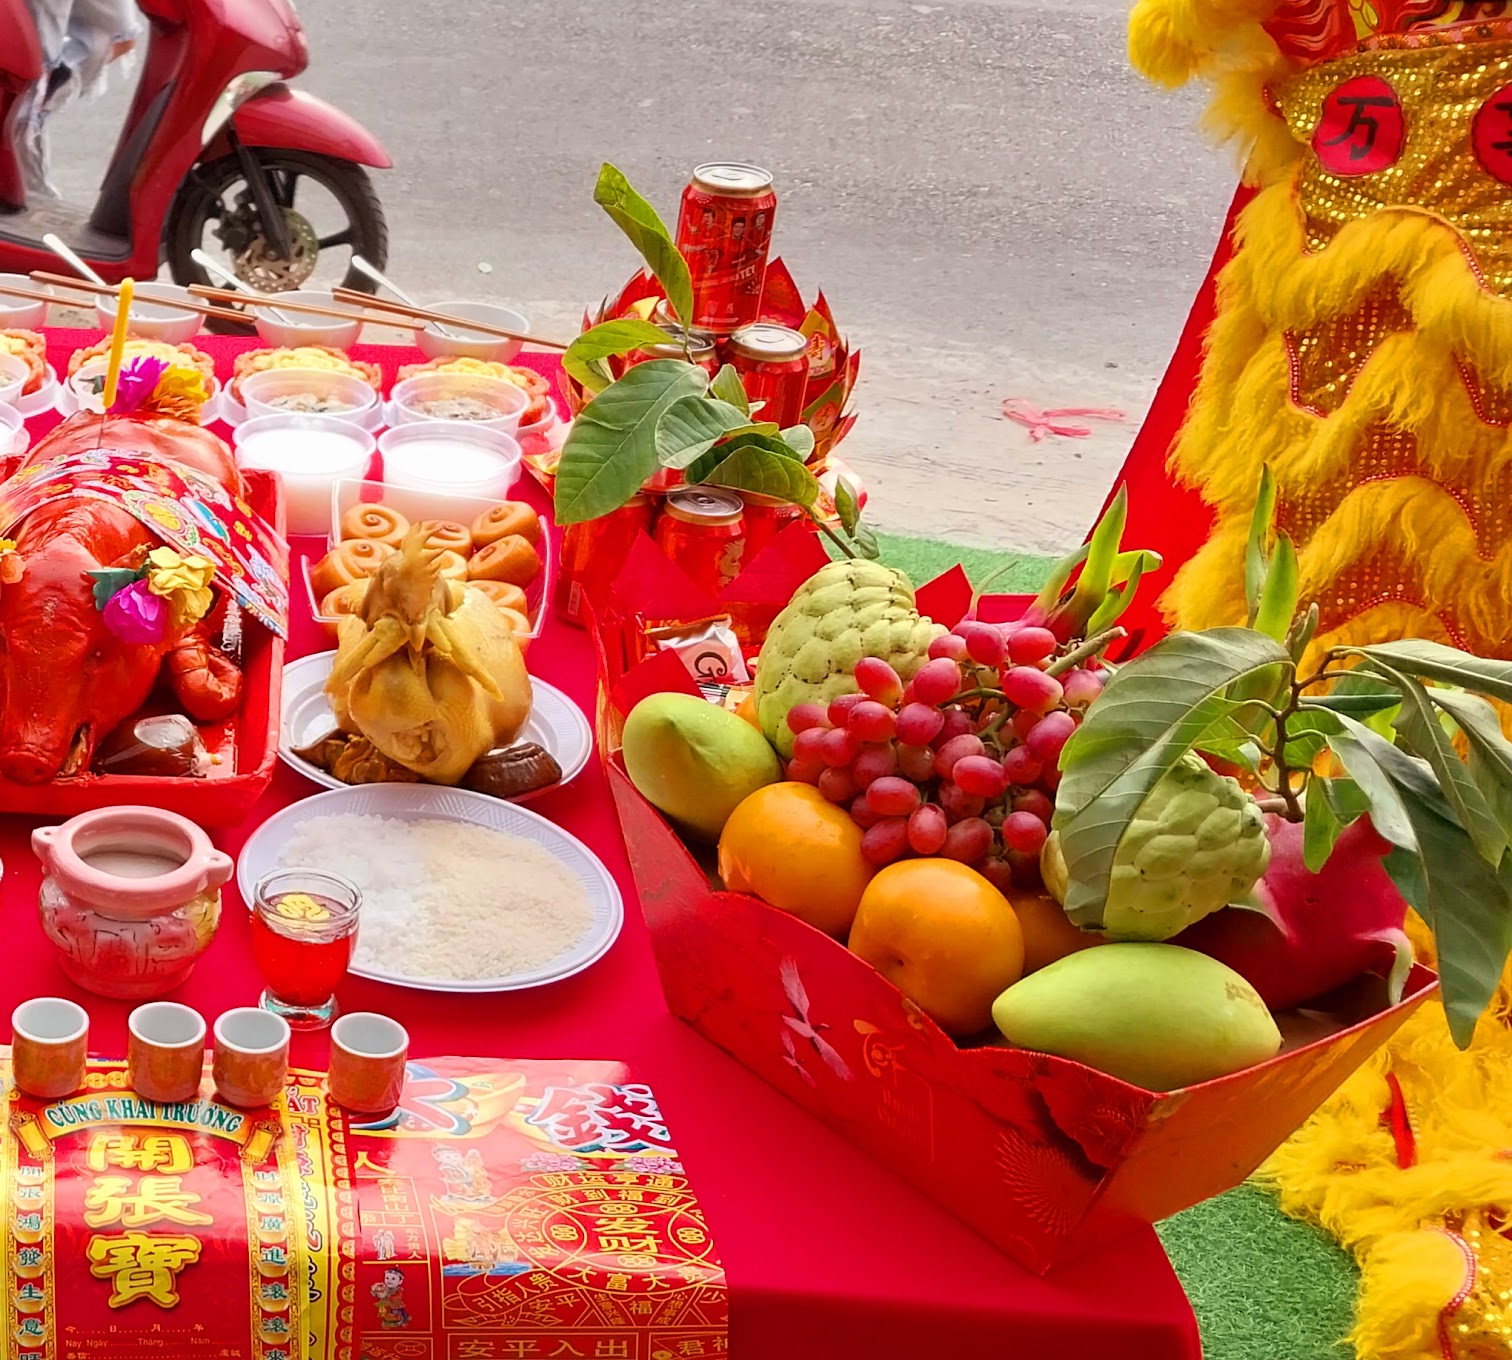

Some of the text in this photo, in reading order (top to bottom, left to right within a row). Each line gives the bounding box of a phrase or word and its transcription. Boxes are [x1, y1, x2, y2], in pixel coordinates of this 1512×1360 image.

[1323, 96, 1394, 161] 万
[105, 1098, 156, 1121] KHAI
[85, 1135, 214, 1308] 開張寶
[592, 1217, 663, 1255] 发财
[629, 1300, 653, 1315] 福
